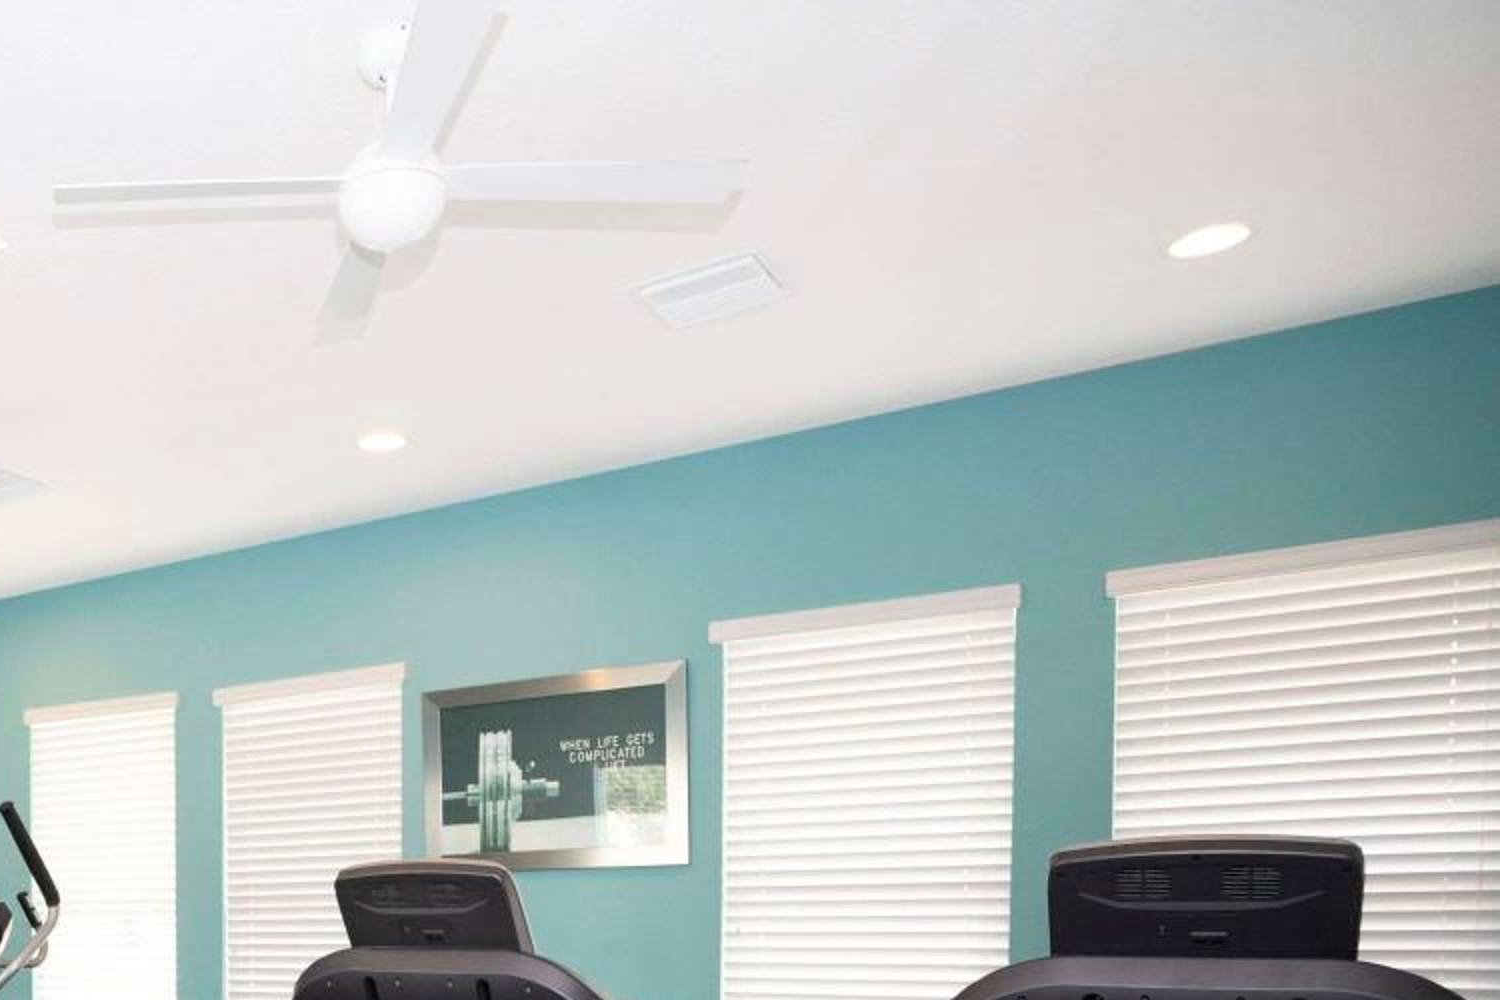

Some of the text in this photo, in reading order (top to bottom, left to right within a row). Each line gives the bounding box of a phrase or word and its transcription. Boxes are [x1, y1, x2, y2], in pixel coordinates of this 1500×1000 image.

[560, 732, 654, 752] WHEN LIFE GETS
[569, 746, 645, 764] COMPLICATED
